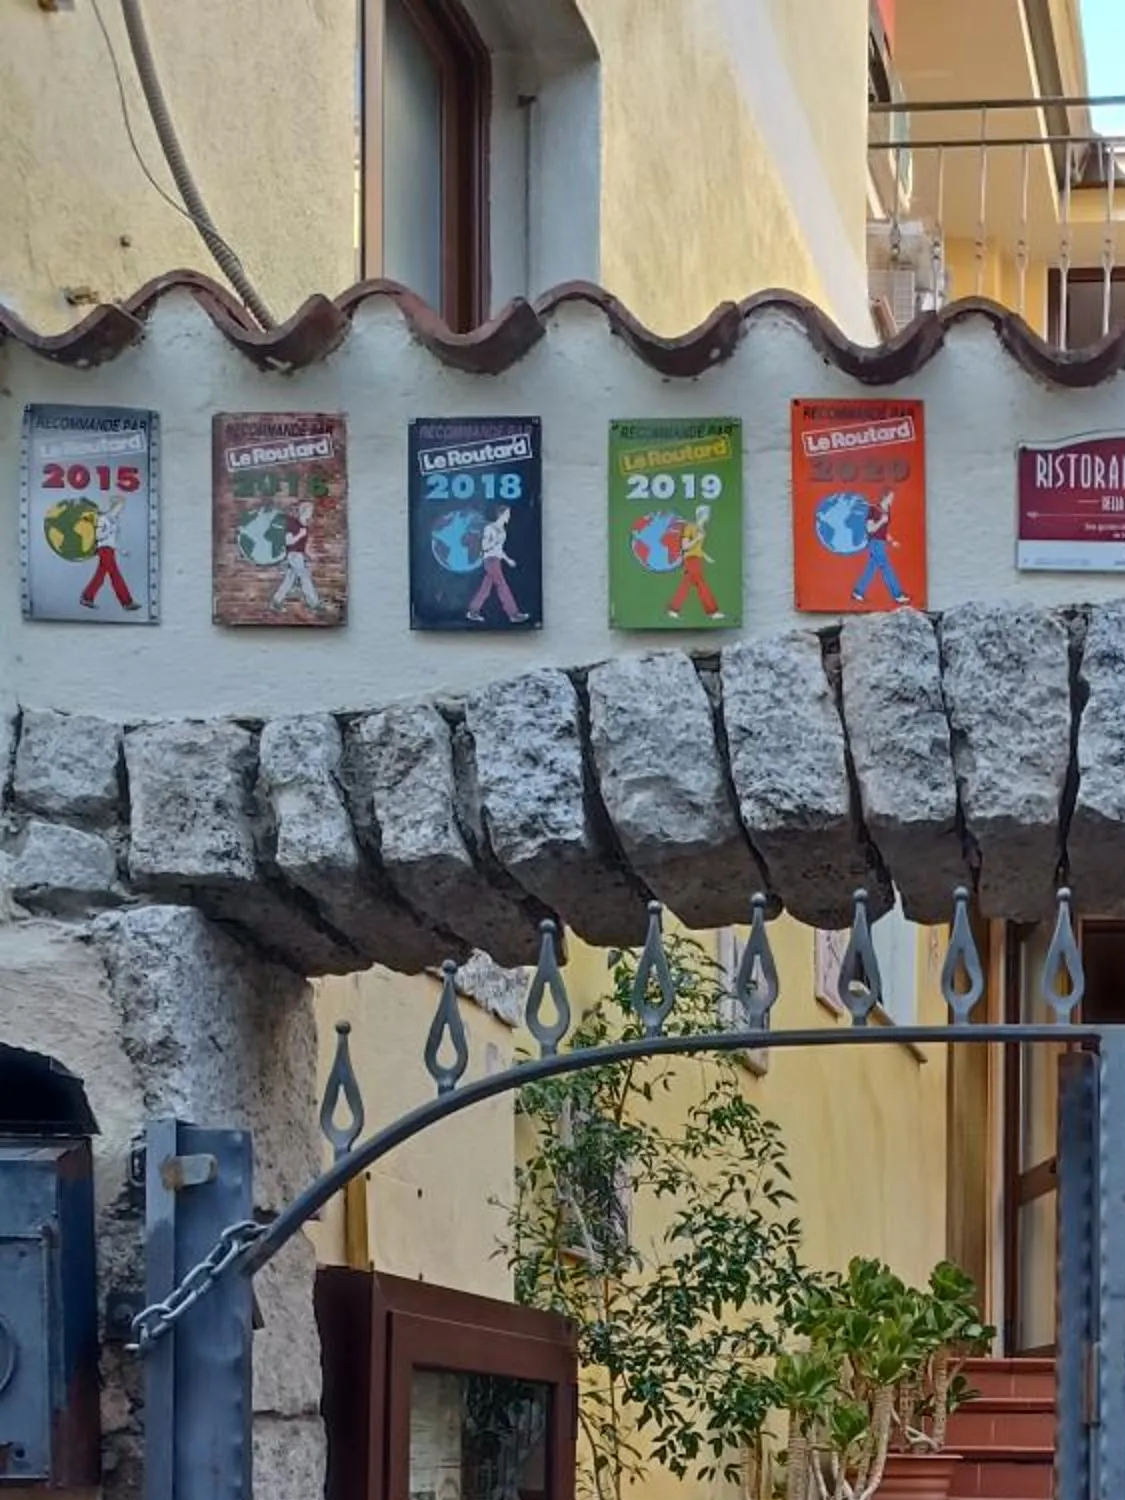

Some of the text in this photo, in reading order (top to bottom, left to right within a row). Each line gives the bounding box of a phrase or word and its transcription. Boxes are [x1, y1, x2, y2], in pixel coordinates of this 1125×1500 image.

[807, 420, 911, 452] Le Routard
[229, 437, 329, 467] Le Routard
[423, 438, 528, 471] Le Routard
[623, 439, 727, 471] Le Routard
[41, 463, 142, 493] 2015
[233, 469, 330, 498] 2016
[810, 458, 911, 483] 2020
[425, 473, 523, 500] 2018
[625, 473, 723, 501] 2019
